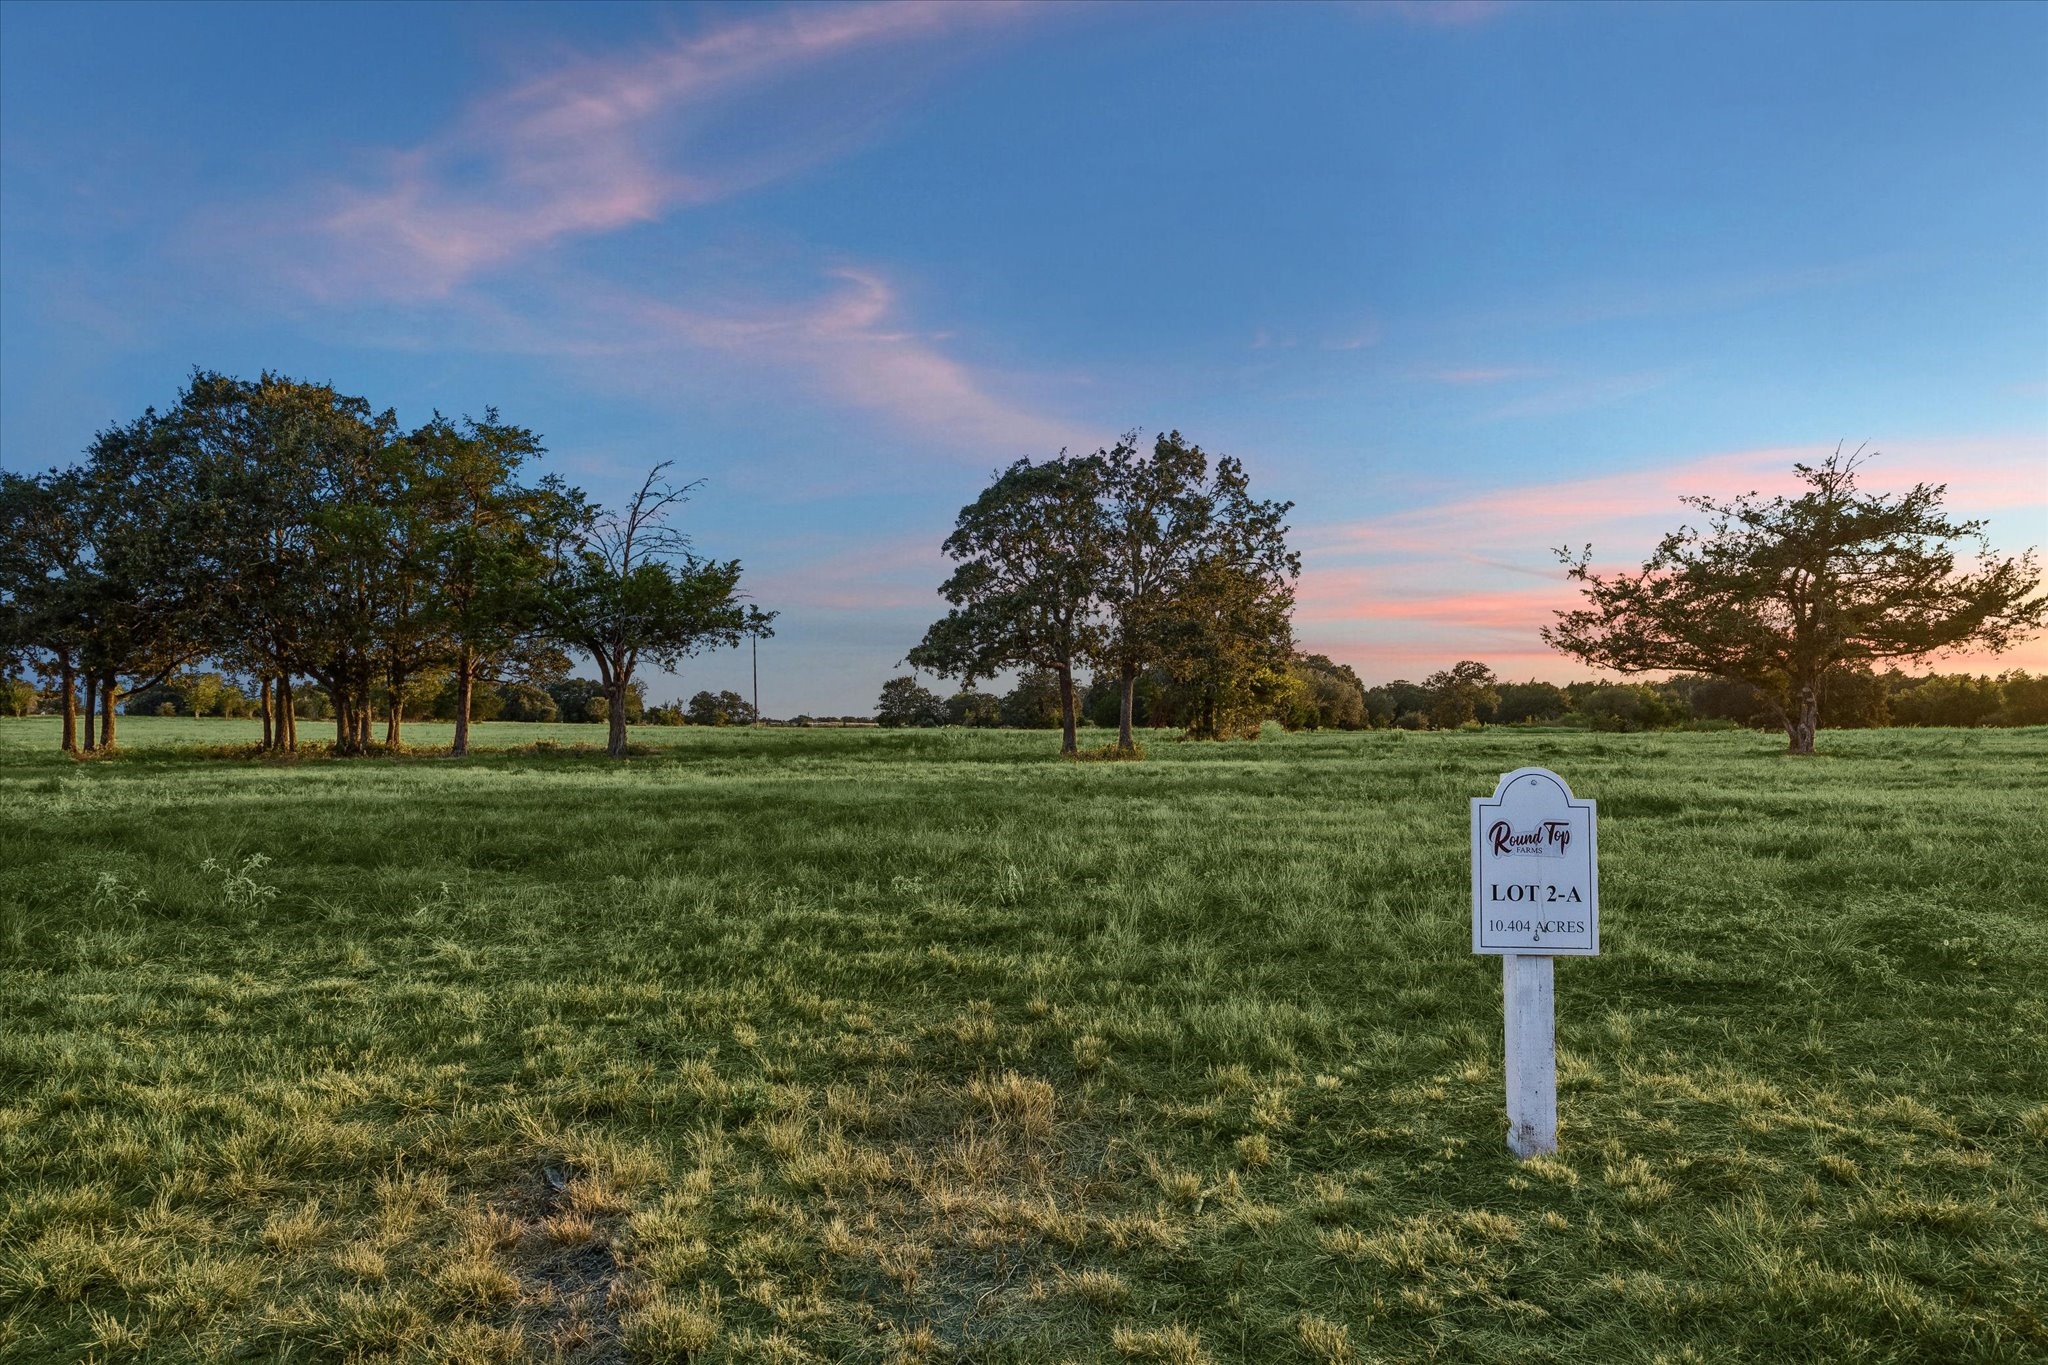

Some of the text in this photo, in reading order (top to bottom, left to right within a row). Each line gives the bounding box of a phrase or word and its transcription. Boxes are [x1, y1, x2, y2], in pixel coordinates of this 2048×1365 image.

[1489, 821, 1570, 856] Round Top
[1491, 884, 1582, 902] LOT 2-A
[1489, 920, 1585, 933] 10.404 ACRES
